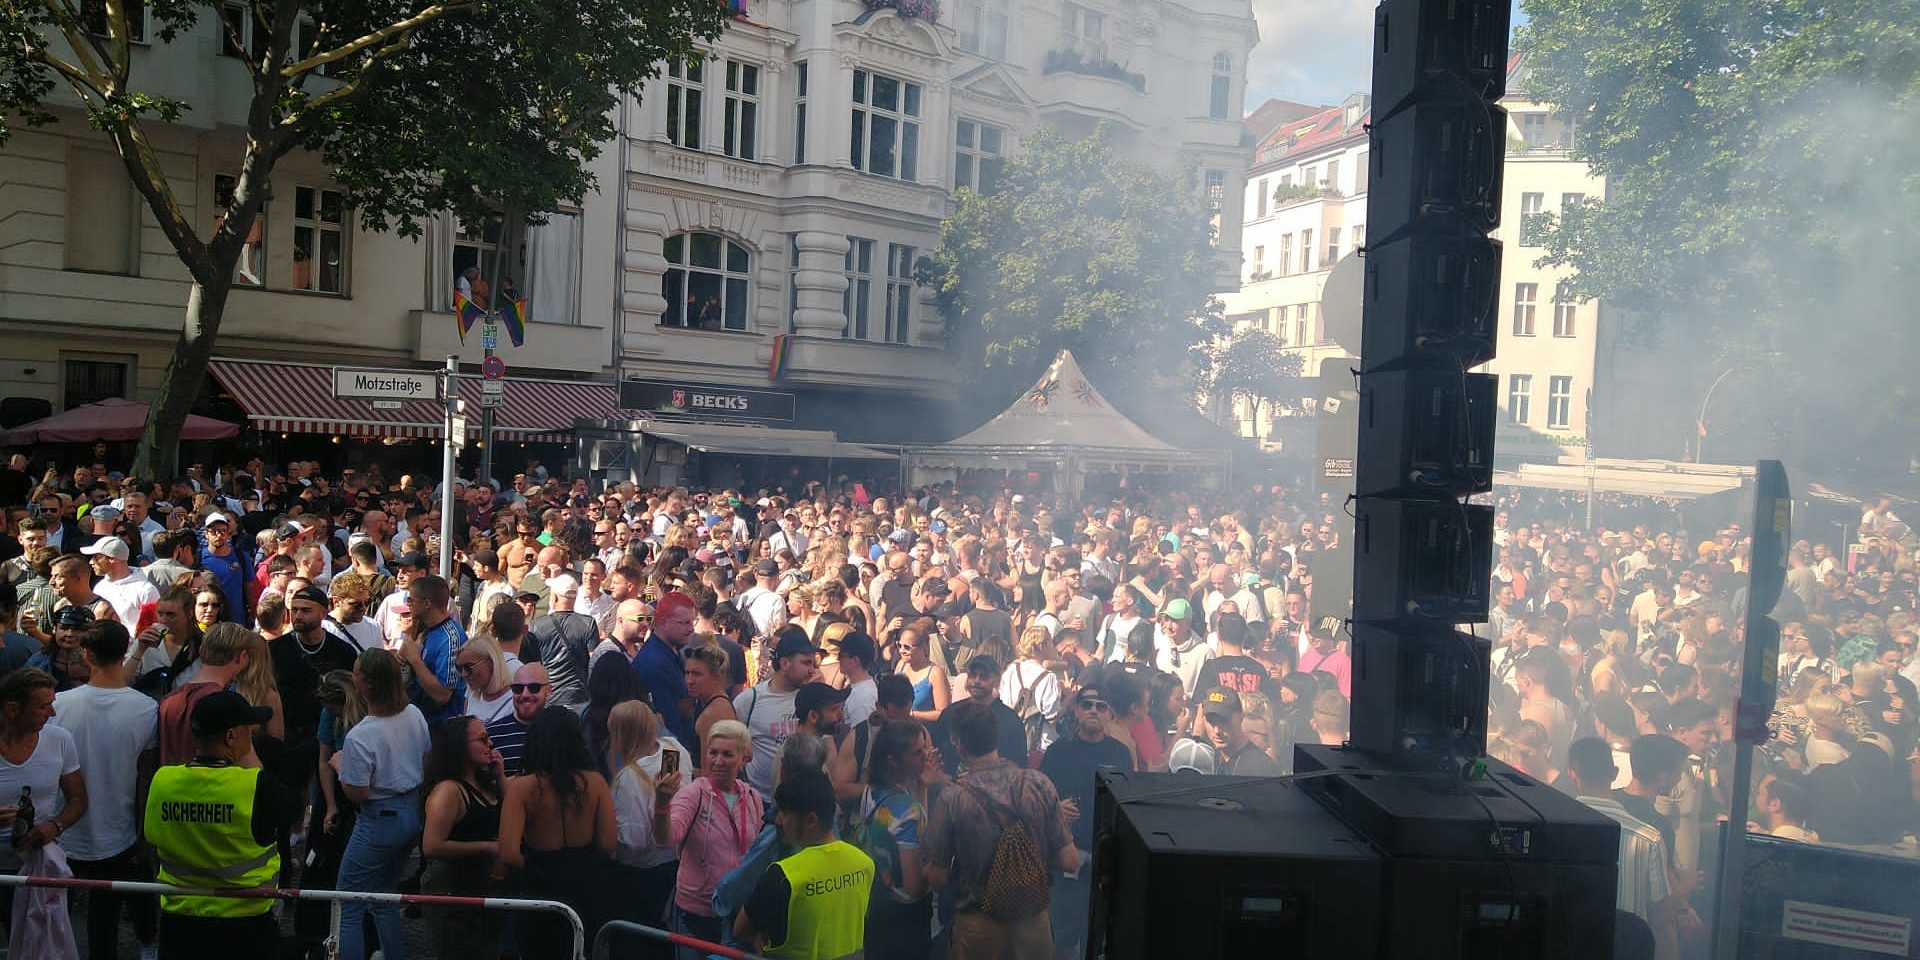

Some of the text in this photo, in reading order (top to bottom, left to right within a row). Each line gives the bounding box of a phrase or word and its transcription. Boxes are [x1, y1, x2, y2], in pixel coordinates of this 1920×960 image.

[355, 374, 422, 395] Motzstraße
[161, 801, 235, 824] SICHERHEIT
[806, 870, 866, 897] SECURITY
